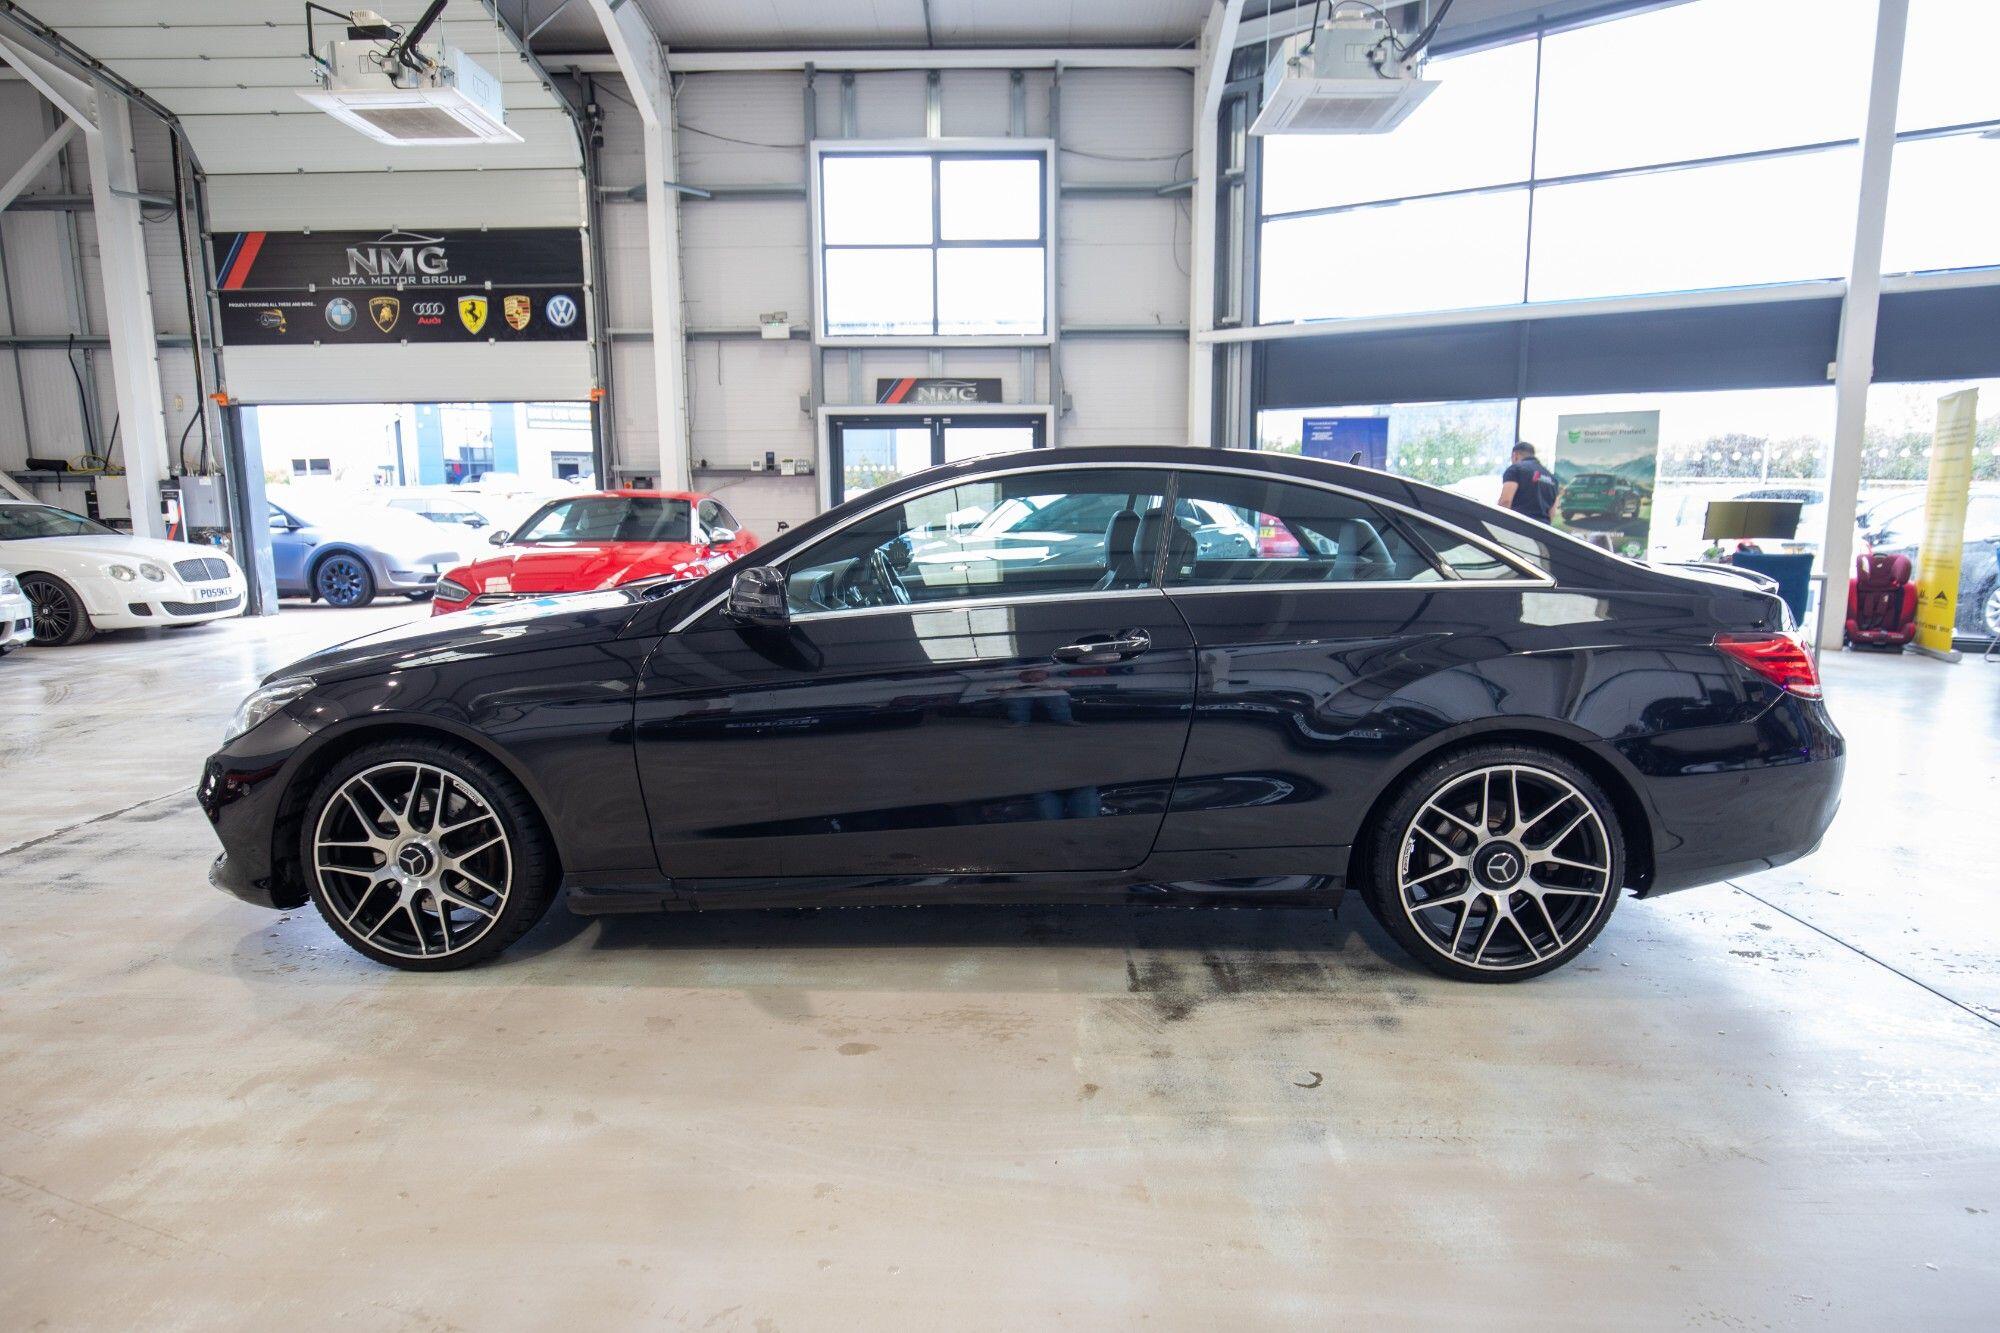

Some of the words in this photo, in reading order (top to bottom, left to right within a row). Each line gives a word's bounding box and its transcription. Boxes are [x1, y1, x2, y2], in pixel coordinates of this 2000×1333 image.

[346, 246, 448, 275] NMG
[332, 277, 366, 285] NOYA
[371, 276, 416, 285] MOTOR
[422, 275, 467, 284] GROUP
[918, 387, 978, 401] NMG
